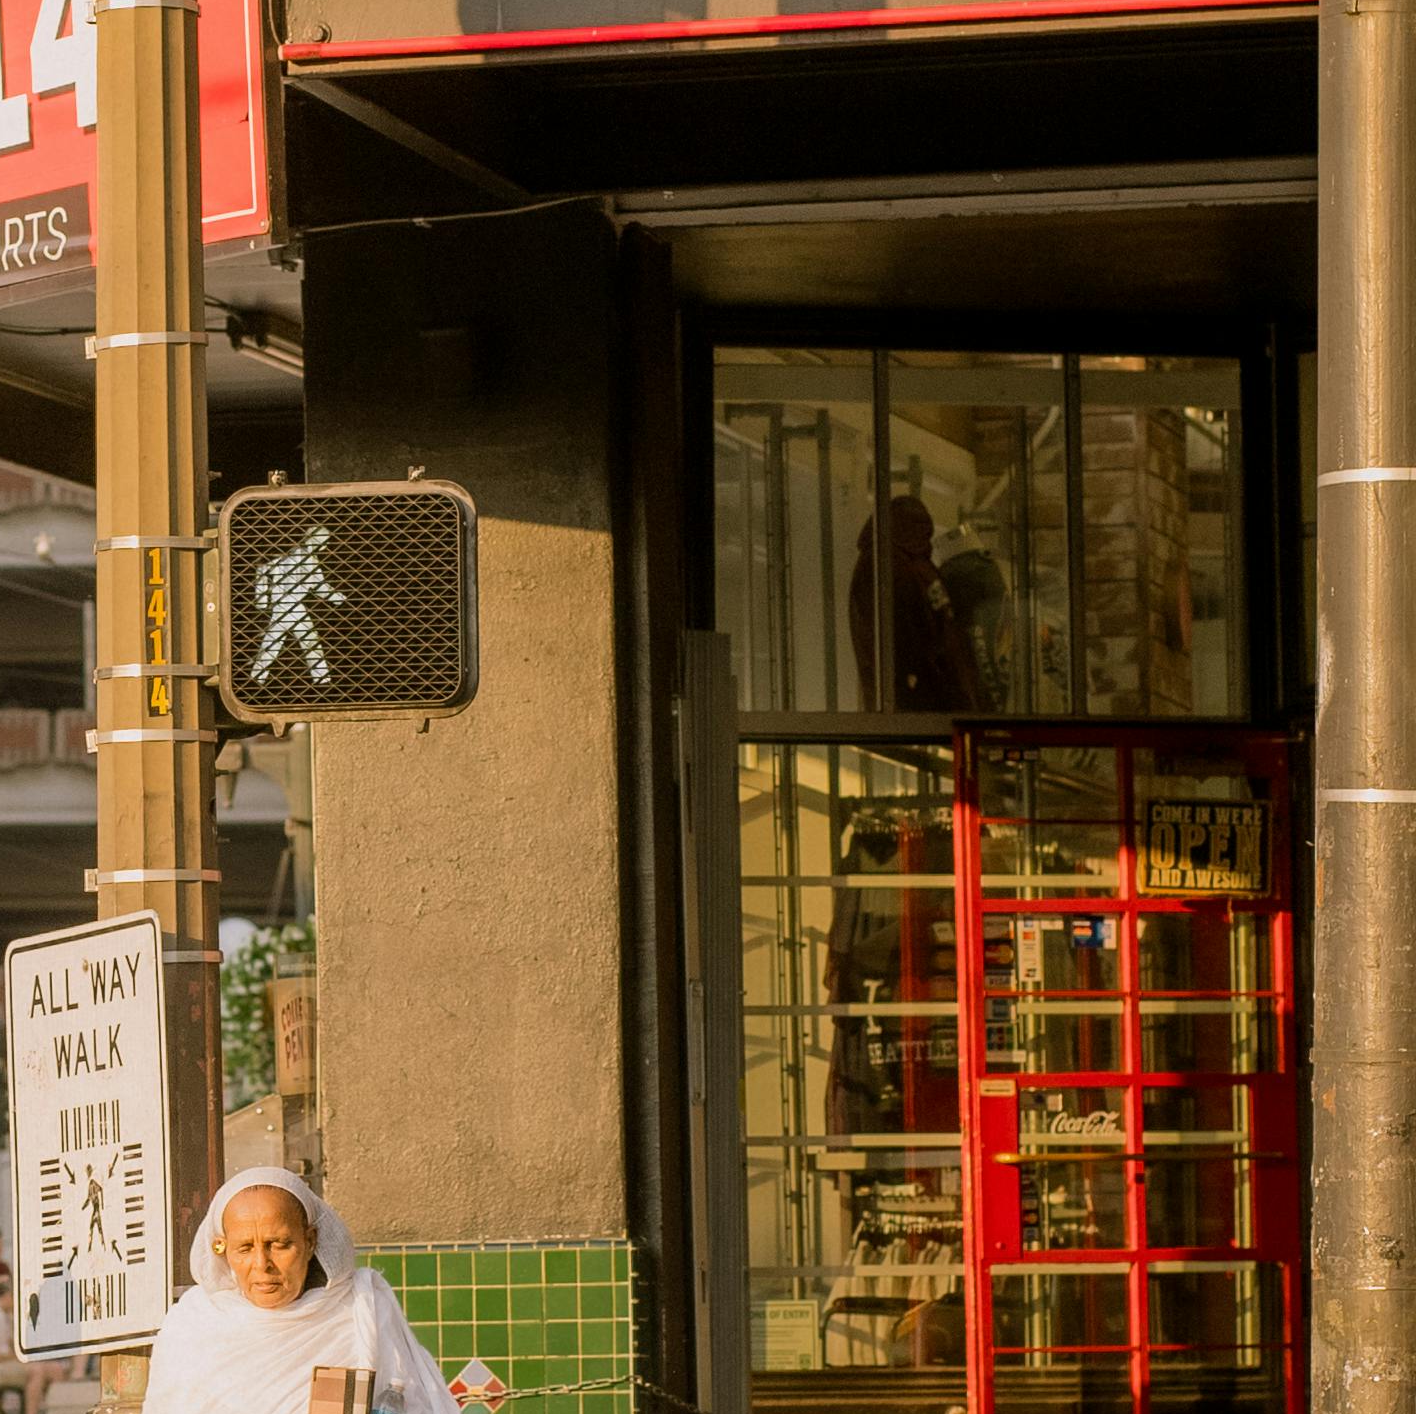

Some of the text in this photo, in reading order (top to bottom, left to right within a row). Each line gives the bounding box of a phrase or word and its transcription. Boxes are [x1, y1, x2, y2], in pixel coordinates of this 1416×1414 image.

[147, 547, 169, 715] 1414
[1150, 822, 1262, 873] OPEN
[1149, 868, 1182, 887] AND
[30, 951, 141, 1019] ALL WAY
[53, 1023, 124, 1079] WALK
